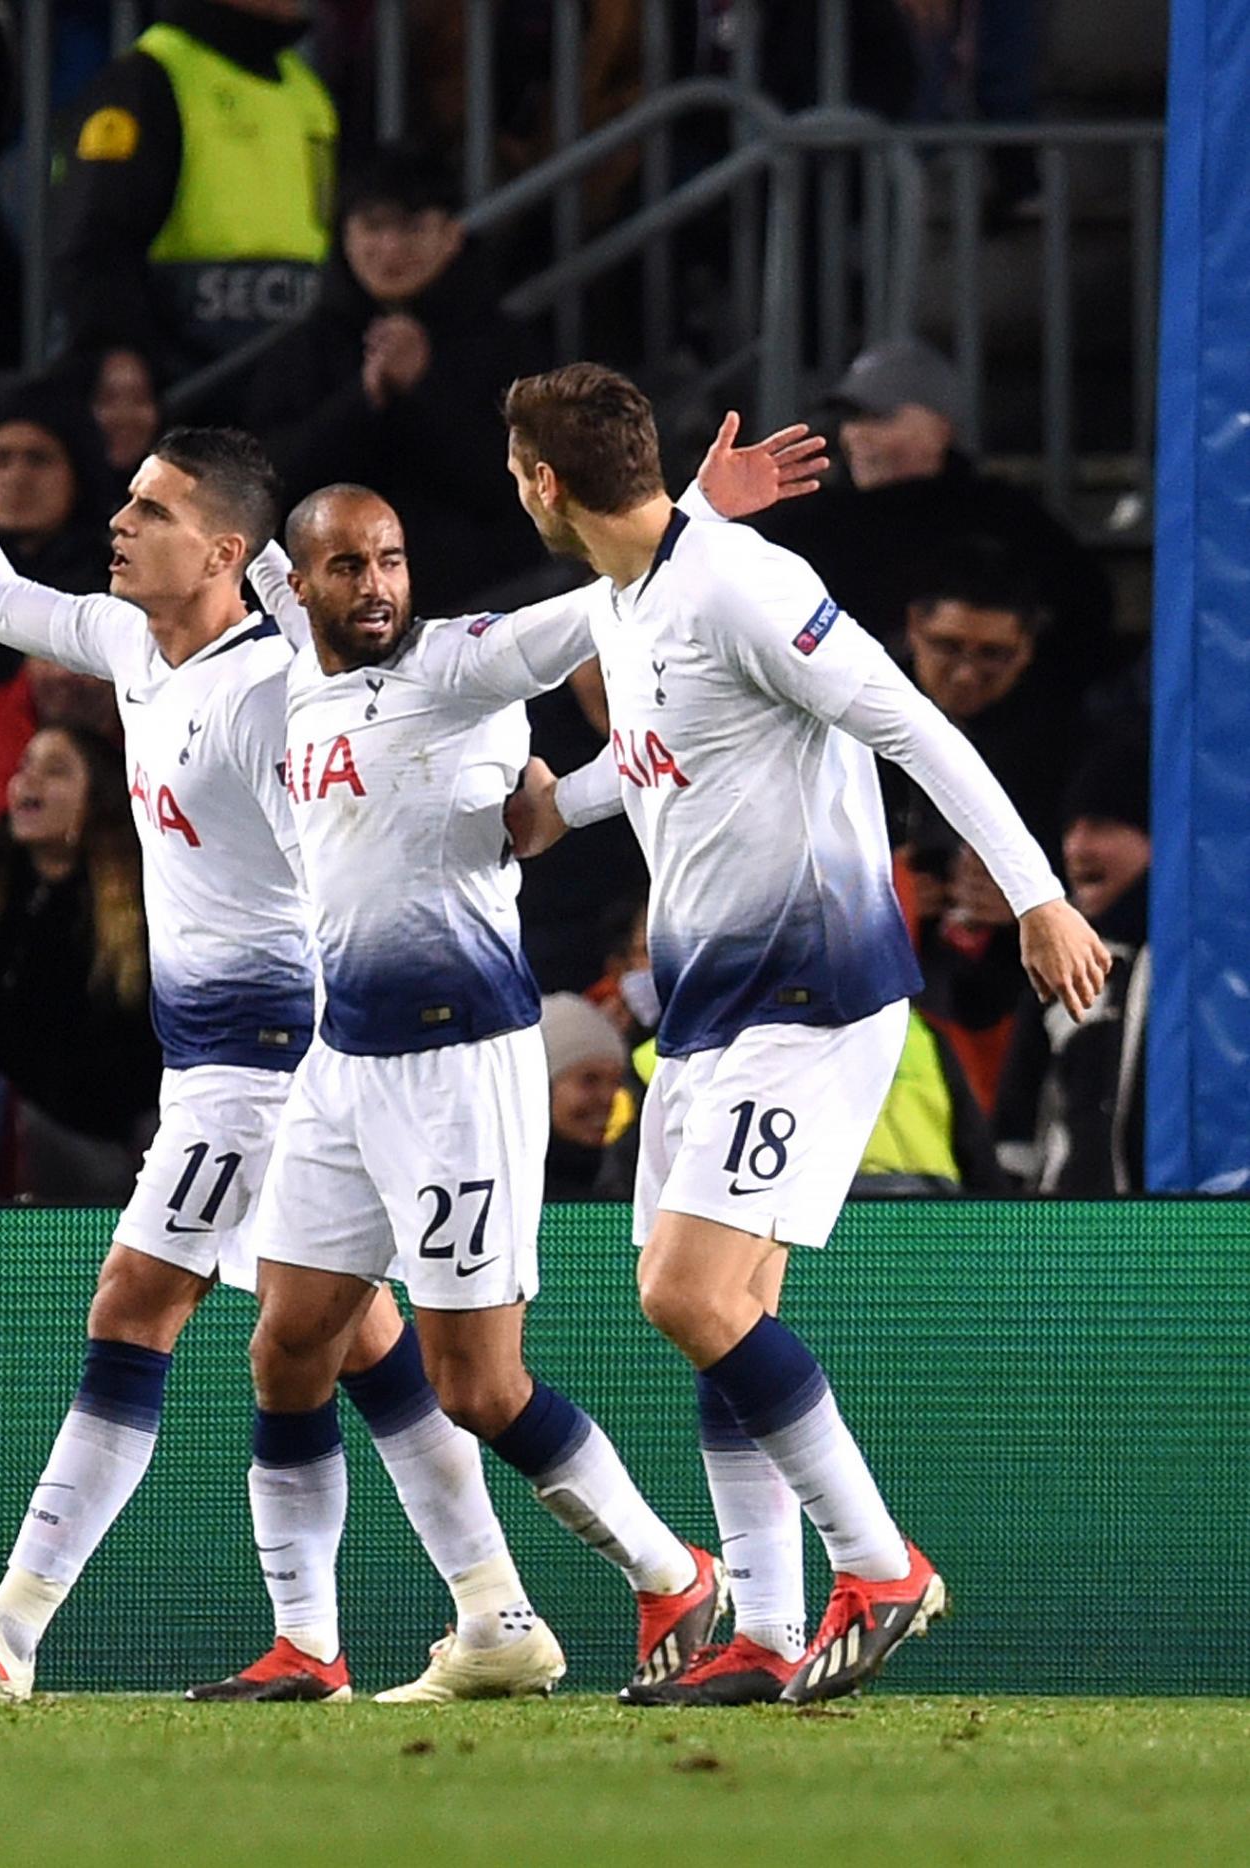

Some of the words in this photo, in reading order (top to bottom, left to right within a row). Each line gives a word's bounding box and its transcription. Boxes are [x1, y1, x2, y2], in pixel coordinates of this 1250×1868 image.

[722, 1099, 797, 1181] 18
[166, 1141, 243, 1226] 11
[416, 1178, 496, 1260] 27
